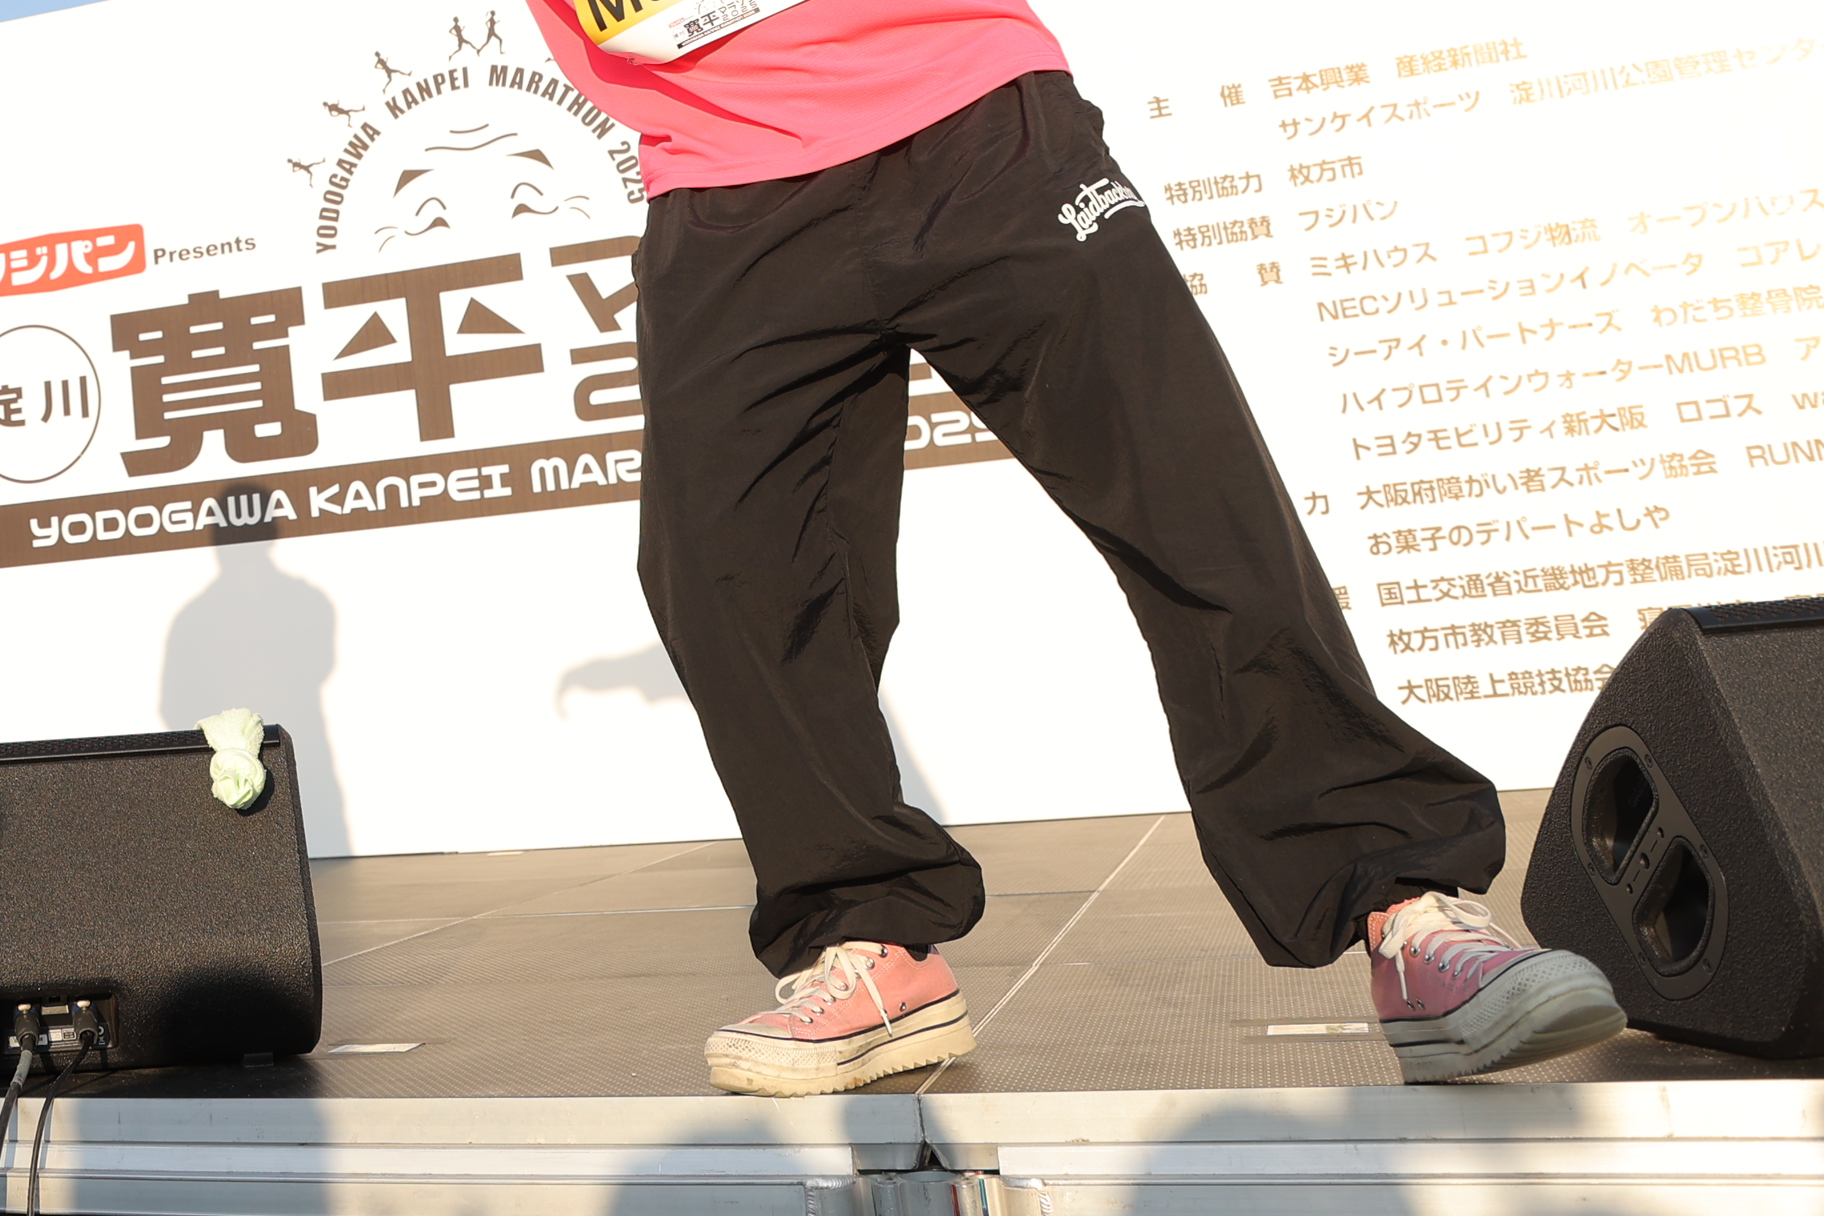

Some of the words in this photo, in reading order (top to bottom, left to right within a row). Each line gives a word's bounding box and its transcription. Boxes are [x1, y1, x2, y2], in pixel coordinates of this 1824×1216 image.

[1268, 62, 1371, 100] 吉本興業
[1395, 37, 1528, 78] 産経新聞社
[1278, 91, 1480, 140] サンケイスポーツ
[1509, 38, 1824, 105] 淀川河川公園管理センタ
[316, 121, 381, 255] YODOGAWA
[384, 66, 470, 120] KANPEI
[488, 64, 616, 140] MARATHON
[607, 140, 647, 205] 2025
[1164, 171, 1263, 206] 特別協力
[1287, 155, 1364, 187] 枚方市
[152, 235, 257, 265] Presents
[1173, 215, 1274, 251] 特別協賛
[1298, 200, 1398, 232] フジパン
[1310, 242, 1438, 277] ミキハウス
[1465, 218, 1601, 256] コフジ物流
[1628, 189, 1824, 234] オープンハウス
[1316, 252, 1703, 322] NECソリューションイノベータ
[1650, 284, 1824, 327] わだち整骨院
[1352, 404, 1648, 461] トヨタモビリティ新大阪
[1675, 393, 1763, 423] ロゴス
[29, 489, 298, 548] YODOGAWA
[309, 463, 513, 516] KANPEI
[1356, 449, 1719, 511] 大阪府障がい者スポーツ協会
[1367, 504, 1670, 556] お菓子のデパートよしや
[1376, 541, 1824, 608] 国土交通省近畿地方整備局淀川河川
[1386, 611, 1611, 655] 枚方市教育委員会
